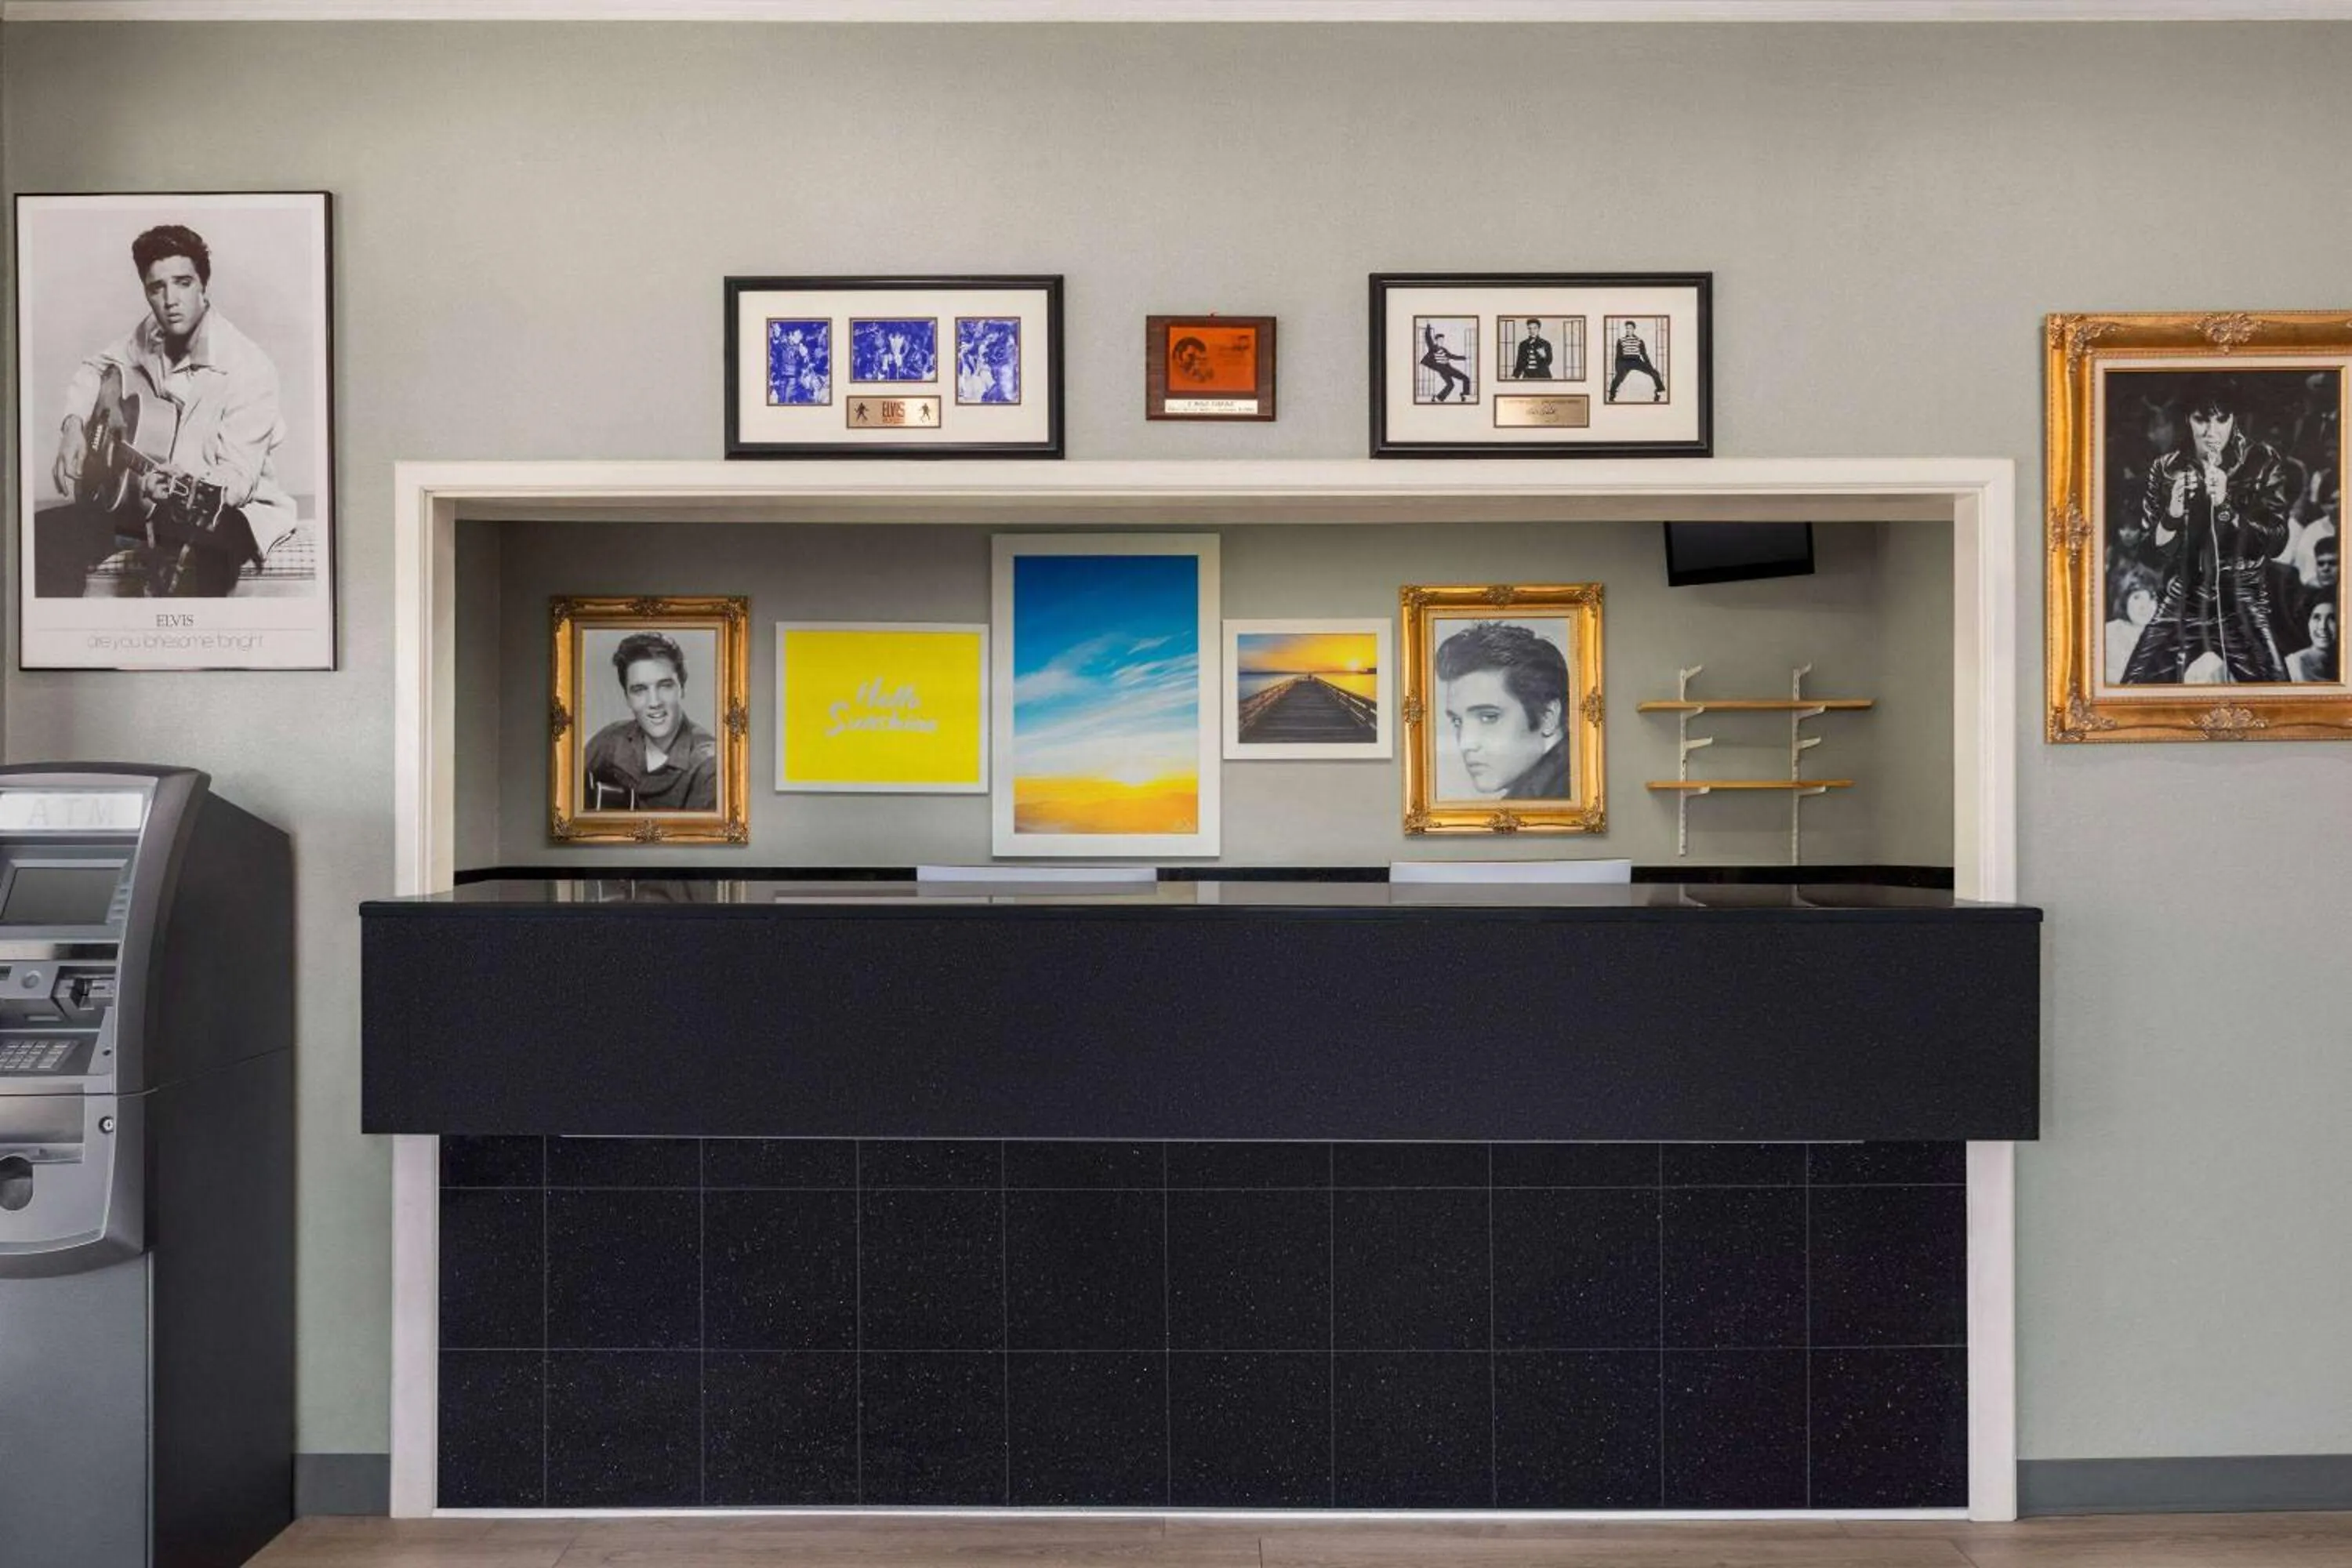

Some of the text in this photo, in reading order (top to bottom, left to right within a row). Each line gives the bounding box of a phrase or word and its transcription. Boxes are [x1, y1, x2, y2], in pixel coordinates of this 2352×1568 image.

[882, 401, 905, 417] ELVIS
[156, 614, 194, 627] ELVIS
[27, 798, 114, 826] ATM
